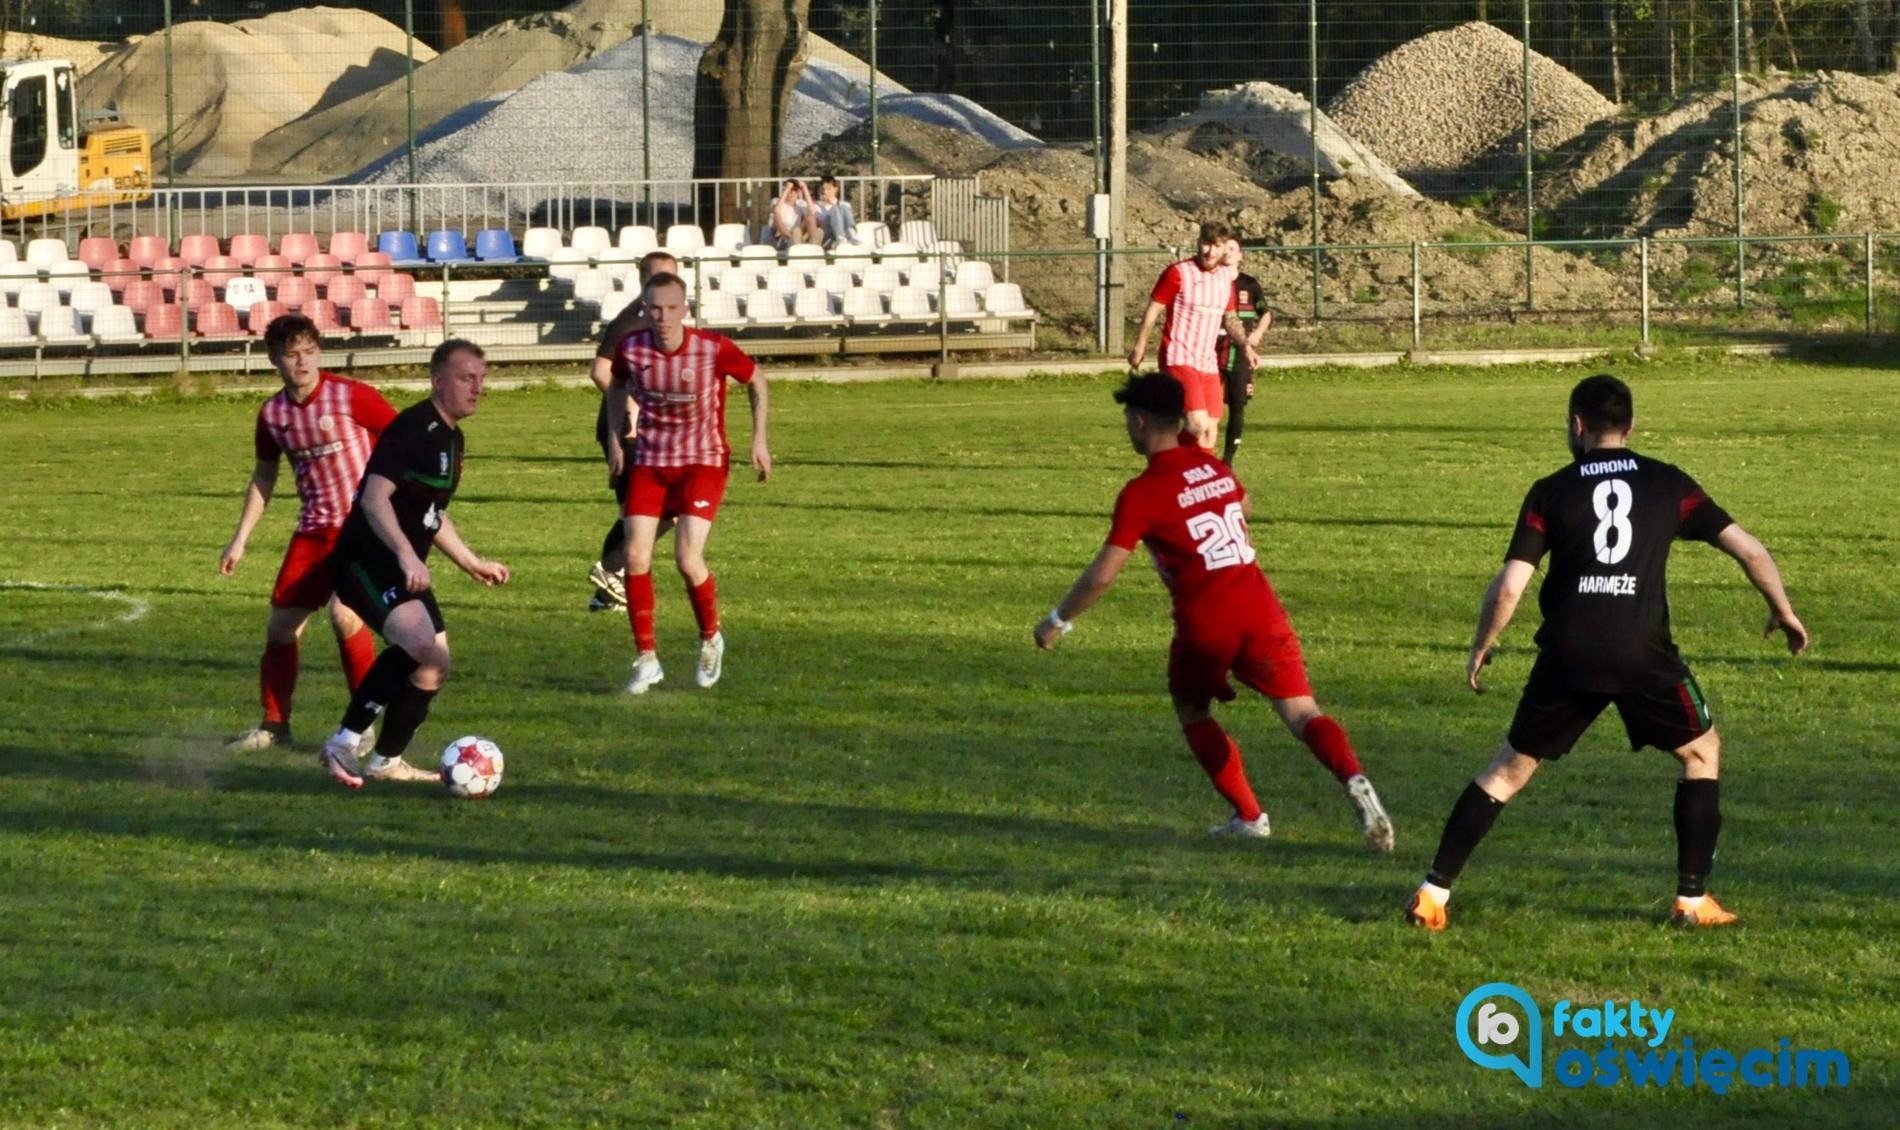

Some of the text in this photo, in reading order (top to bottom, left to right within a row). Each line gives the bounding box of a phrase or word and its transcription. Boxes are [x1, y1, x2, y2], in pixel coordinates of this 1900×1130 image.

[1580, 458, 1638, 477] KORONA
[1185, 502, 1256, 571] 20
[1592, 478, 1633, 565] 8
[1578, 573, 1636, 596] HARMĘŻE
